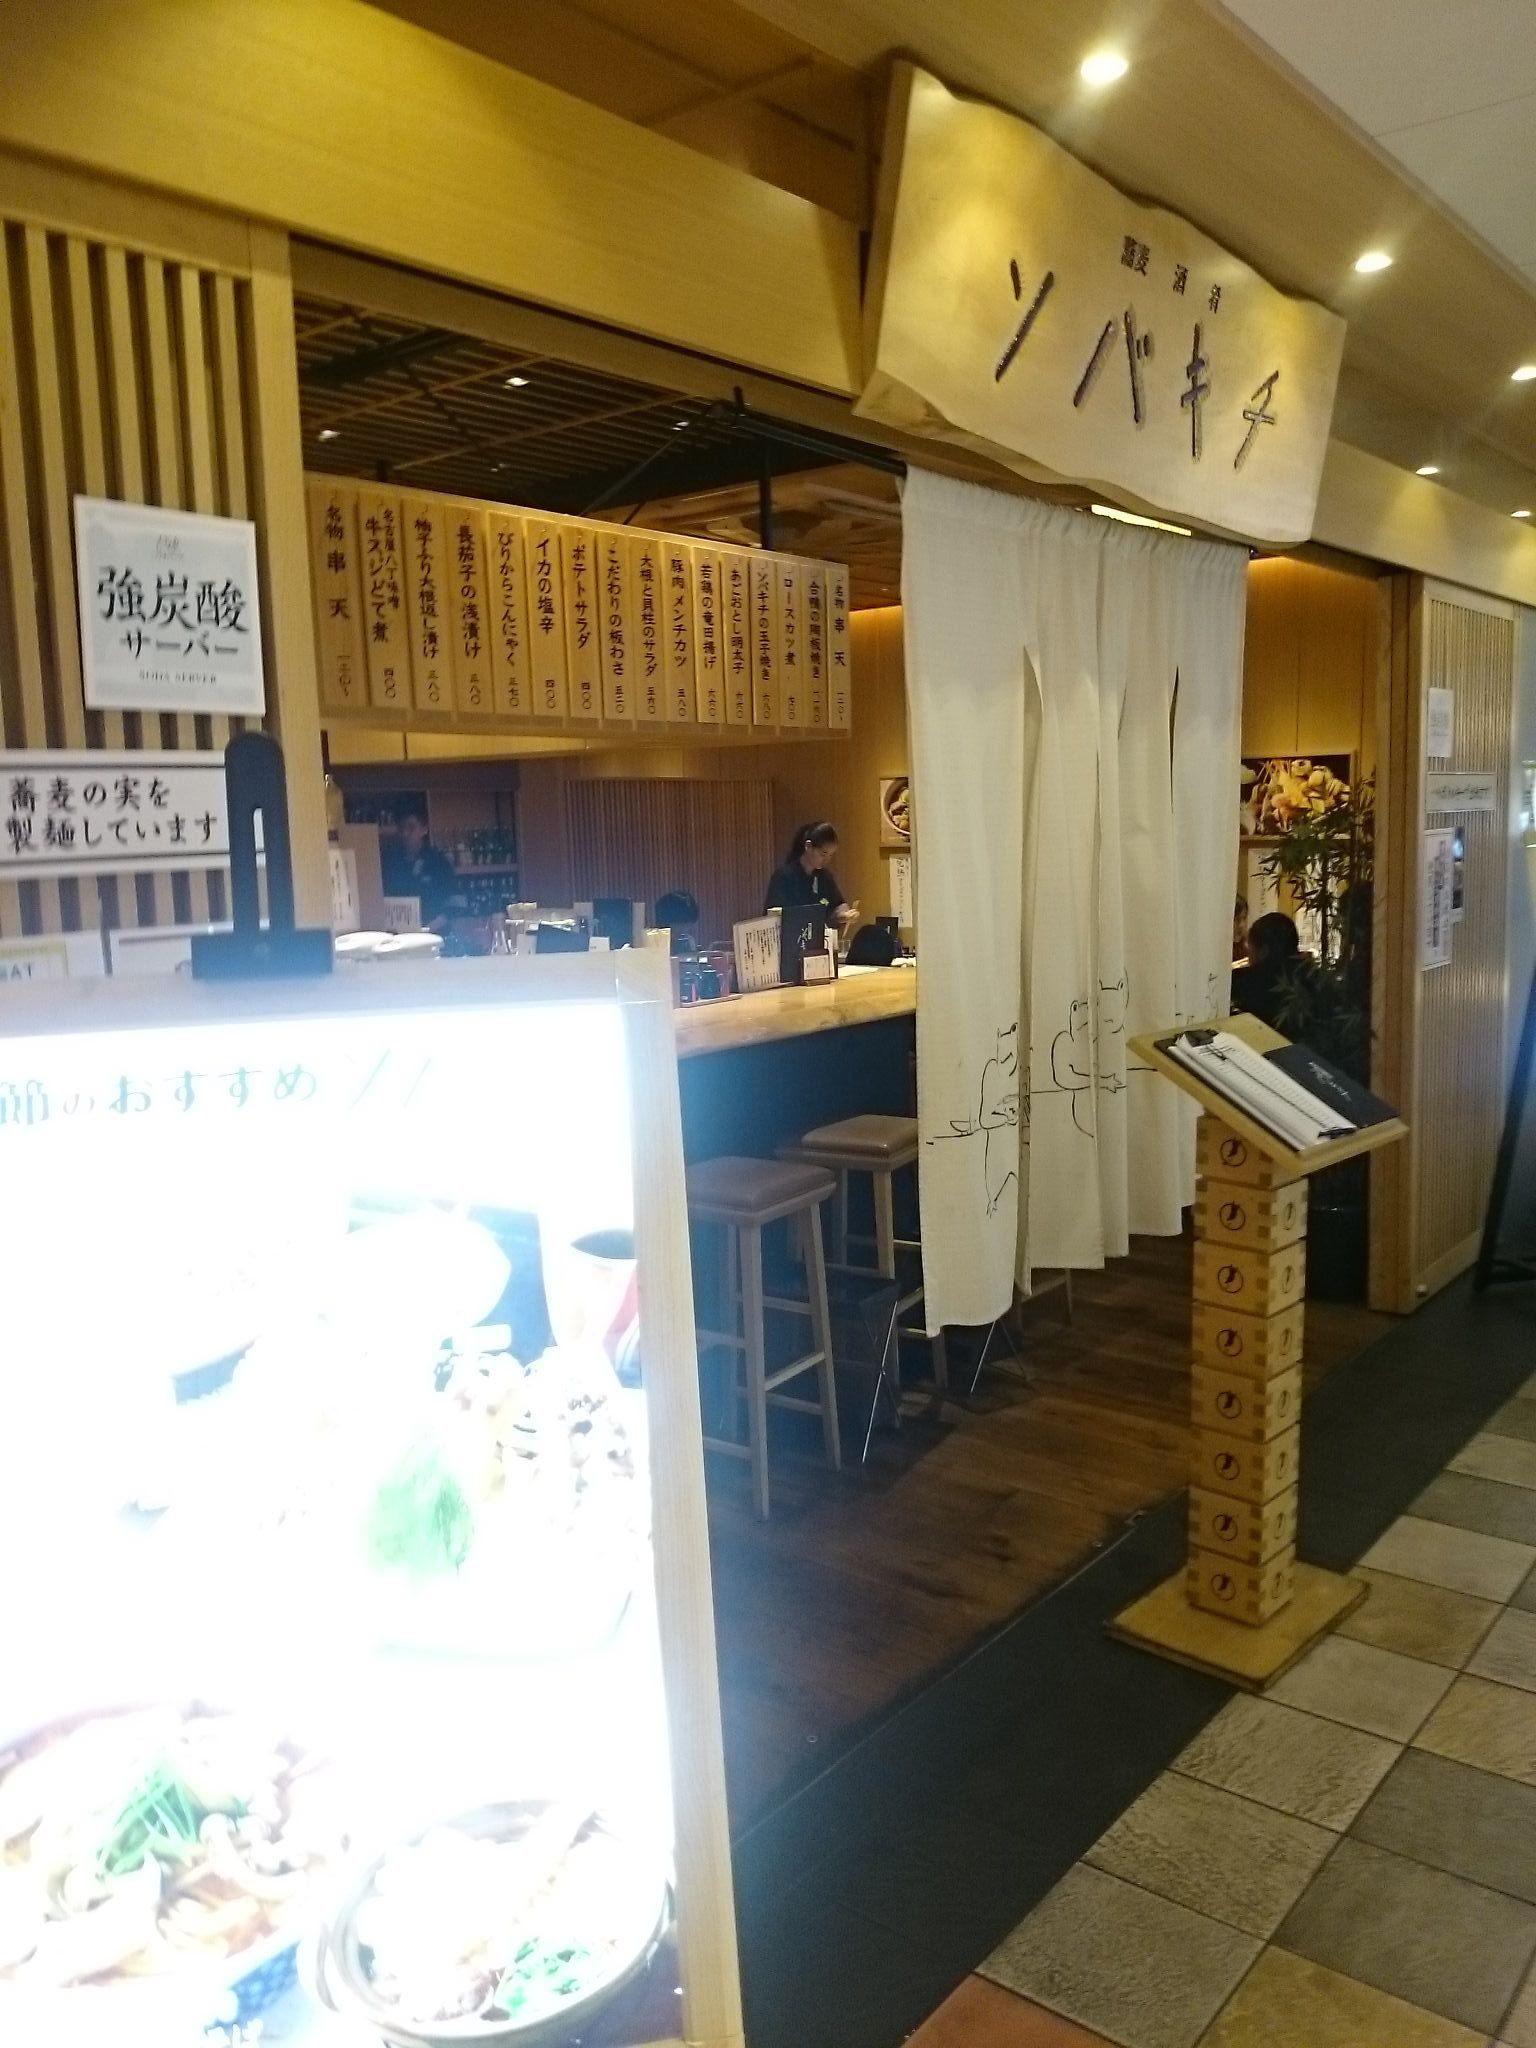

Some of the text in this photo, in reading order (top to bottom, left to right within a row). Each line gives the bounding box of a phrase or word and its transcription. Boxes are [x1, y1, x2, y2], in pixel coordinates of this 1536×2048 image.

[996, 257, 1281, 471] ソバキチ
[97, 564, 249, 633] 強炭酸
[536, 539, 555, 634] イカの塩辛
[607, 549, 625, 676] こだわりの板わさ
[120, 627, 239, 660] サーバー
[6, 811, 219, 854] 製麺しています
